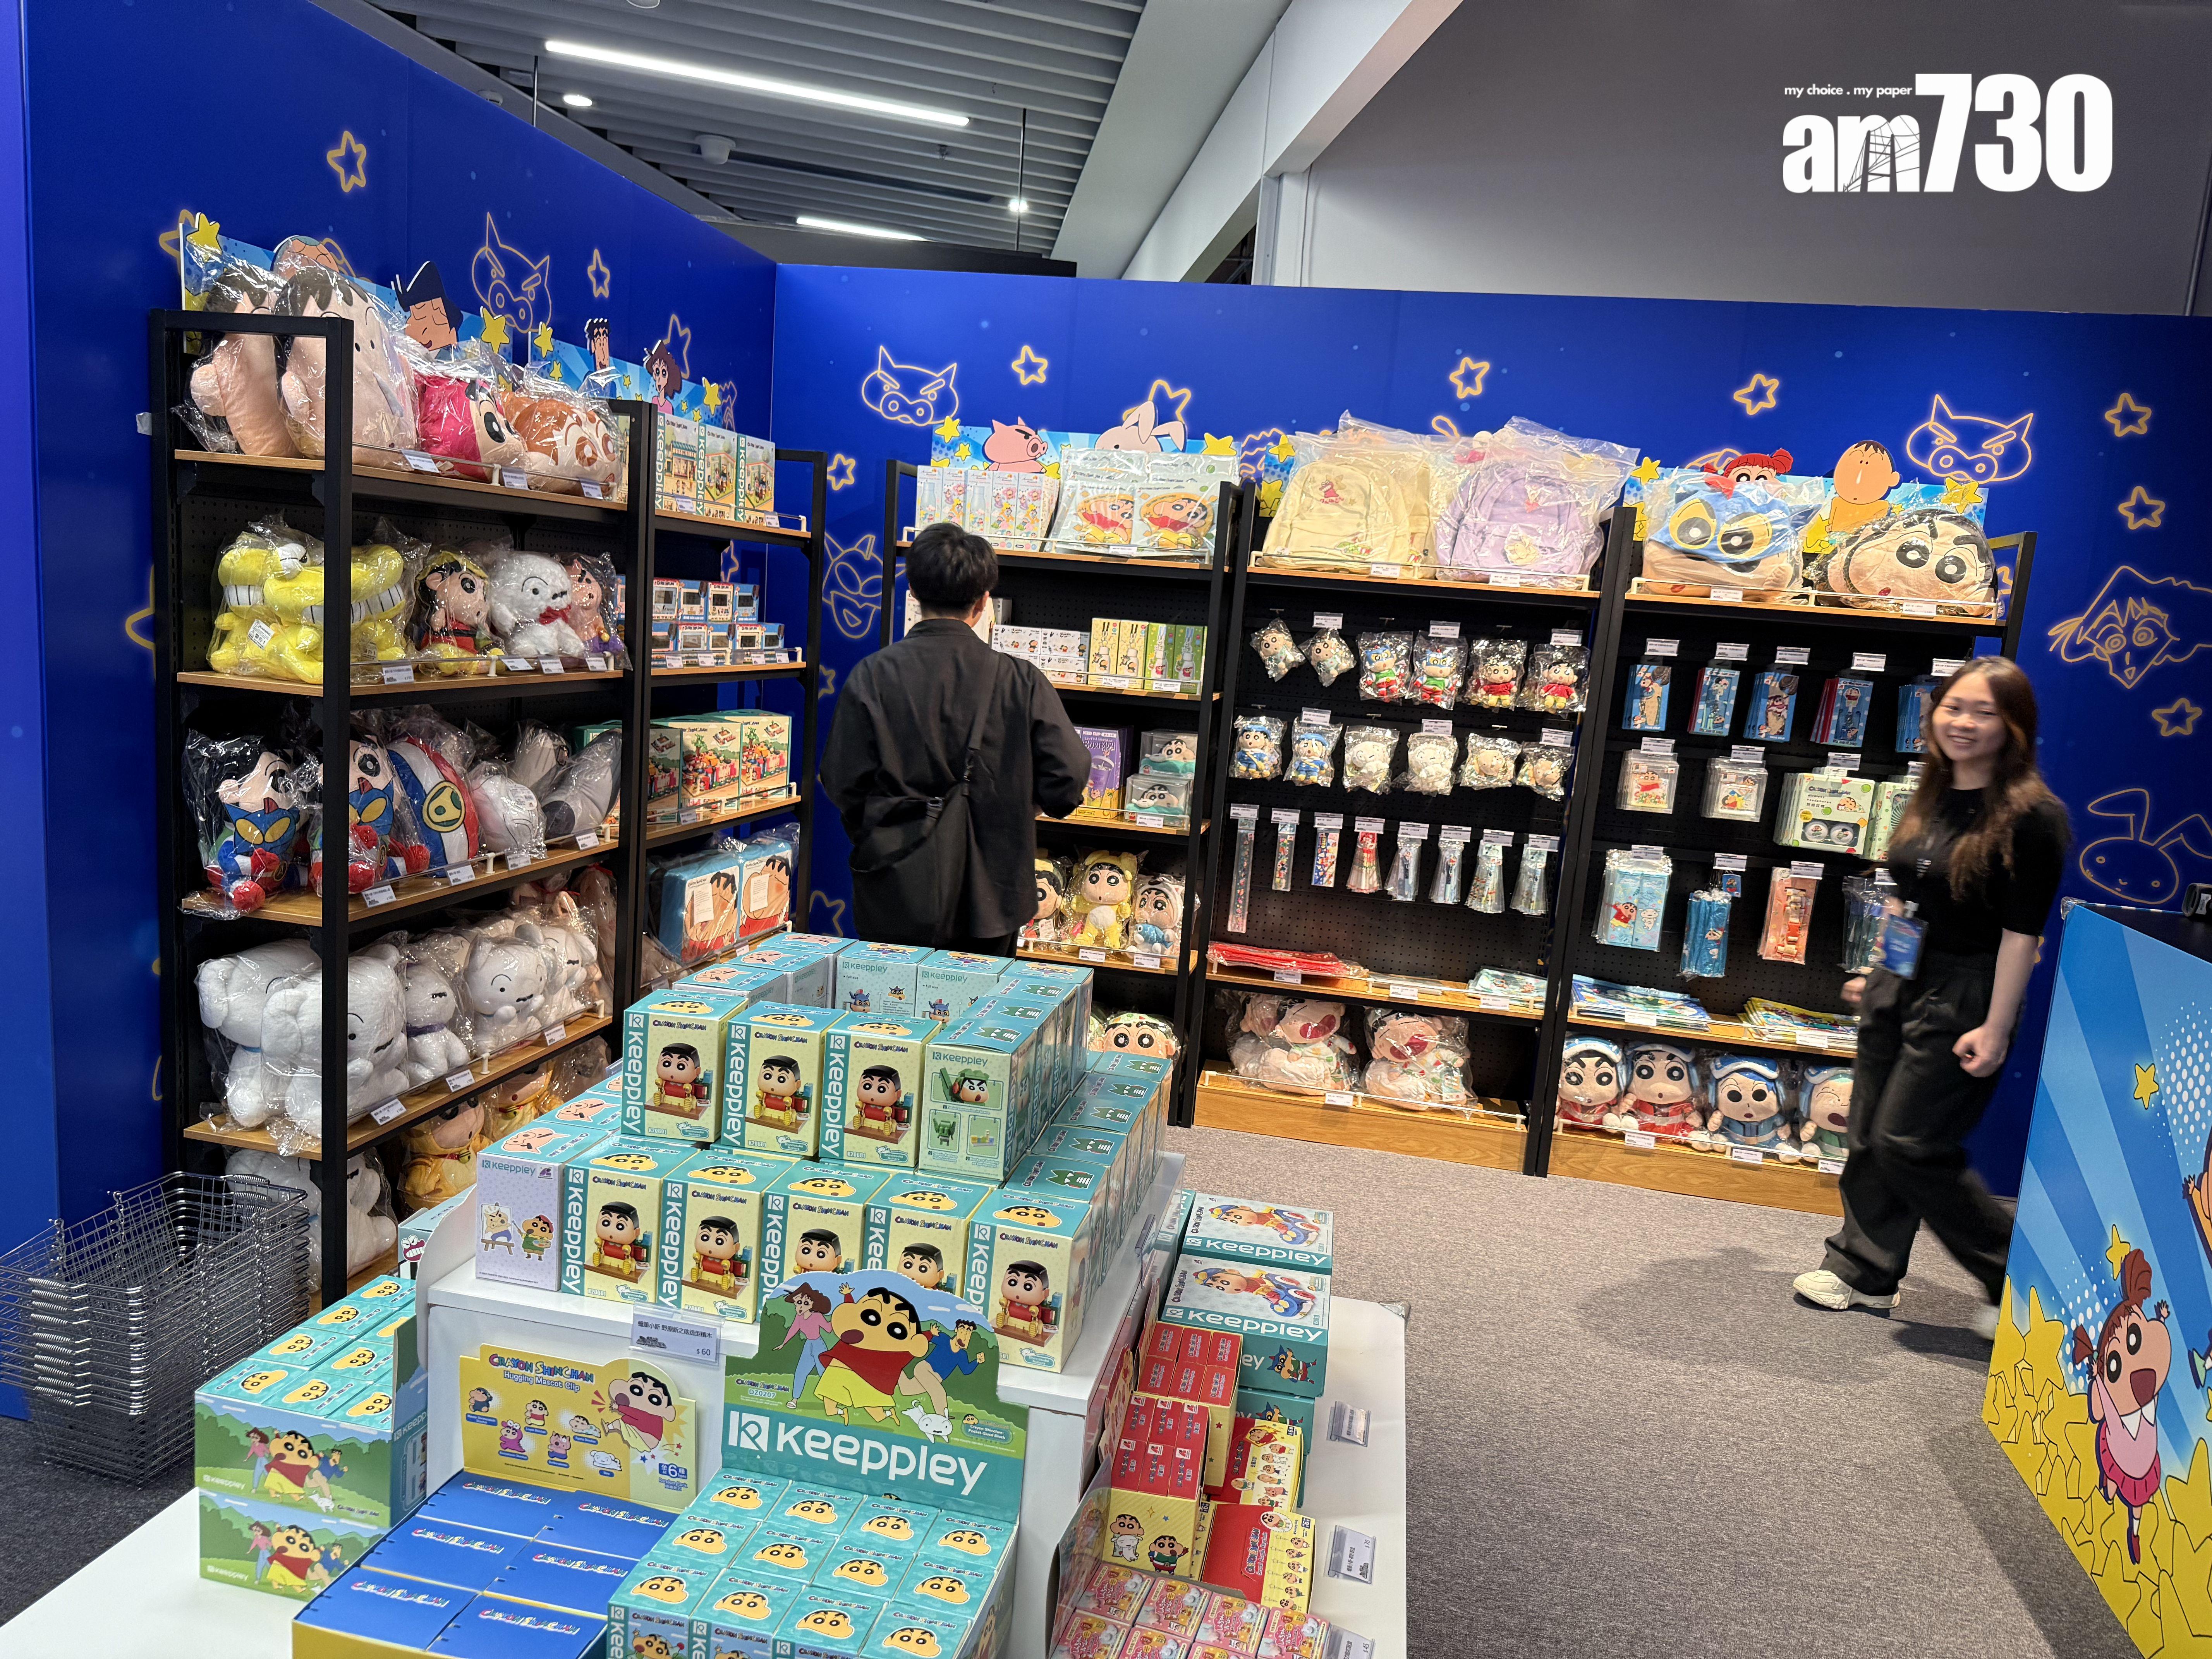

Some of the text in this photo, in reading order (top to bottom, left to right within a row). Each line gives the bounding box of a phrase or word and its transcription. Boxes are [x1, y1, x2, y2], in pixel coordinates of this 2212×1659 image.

[851, 963, 888, 974] Keeppley
[931, 972, 968, 984] Keeppley
[943, 1053, 988, 1066] Keeppley
[623, 1031, 644, 1133] Keeppley
[724, 1042, 746, 1145] Keeppley
[822, 1053, 845, 1157] Keeppley
[492, 1161, 536, 1176] Keeppley
[563, 1187, 583, 1294] Keeppley
[659, 1200, 682, 1308] Keeppley
[1206, 1240, 1328, 1266] Keeppley
[761, 1213, 784, 1307] Keeppl
[1188, 1309, 1323, 1342] Keeppley
[489, 1353, 594, 1384] CRAYON SHINCHAN
[504, 1371, 580, 1393] Hugging Mascot Clip
[749, 1389, 776, 1399] DZ0207
[402, 1413, 426, 1434] Keepp
[668, 1465, 678, 1477] 6
[776, 1422, 987, 1495] Keeppley
